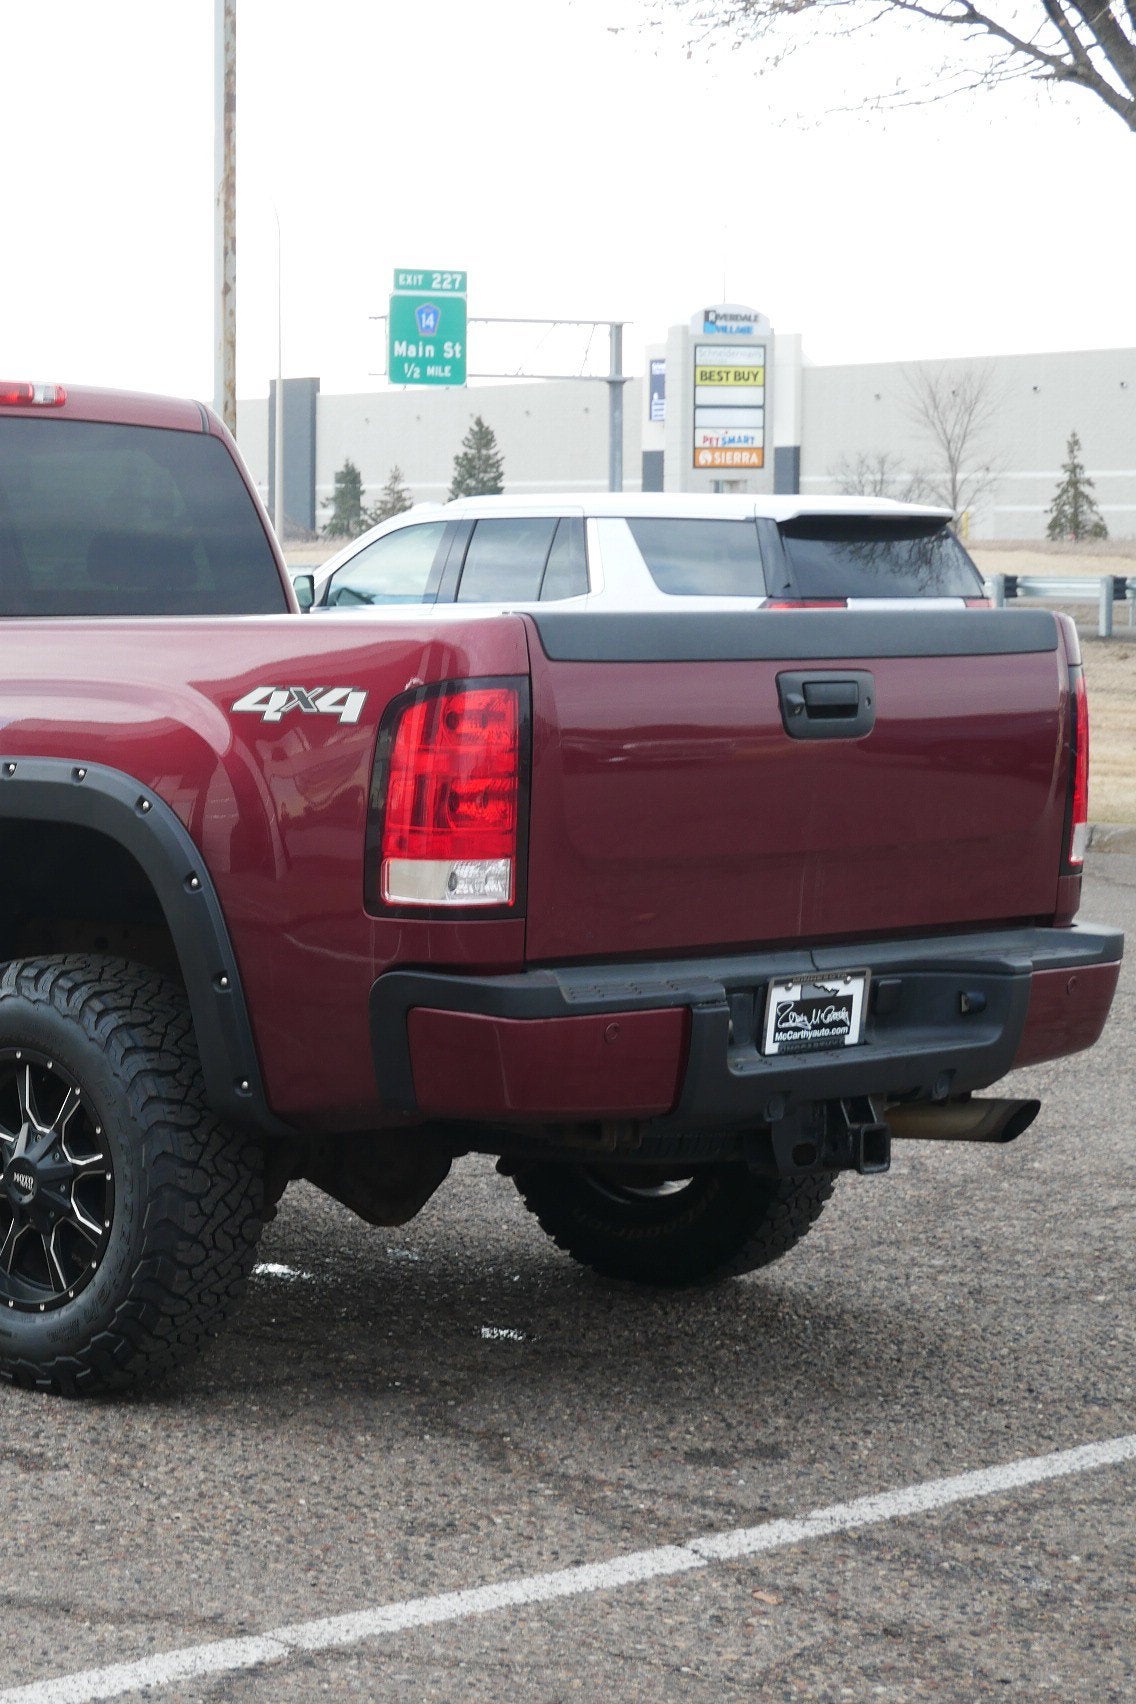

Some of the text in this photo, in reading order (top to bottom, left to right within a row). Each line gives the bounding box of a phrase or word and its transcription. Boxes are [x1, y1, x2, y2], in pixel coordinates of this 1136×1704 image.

[398, 273, 462, 290] EXIT 227
[420, 313, 435, 328] 14
[394, 340, 462, 358] Main St
[426, 365, 452, 378] MILE
[700, 370, 759, 382] BEST BUY
[714, 451, 758, 464] SIERRA
[774, 1026, 849, 1041] McCarthyauto.com
